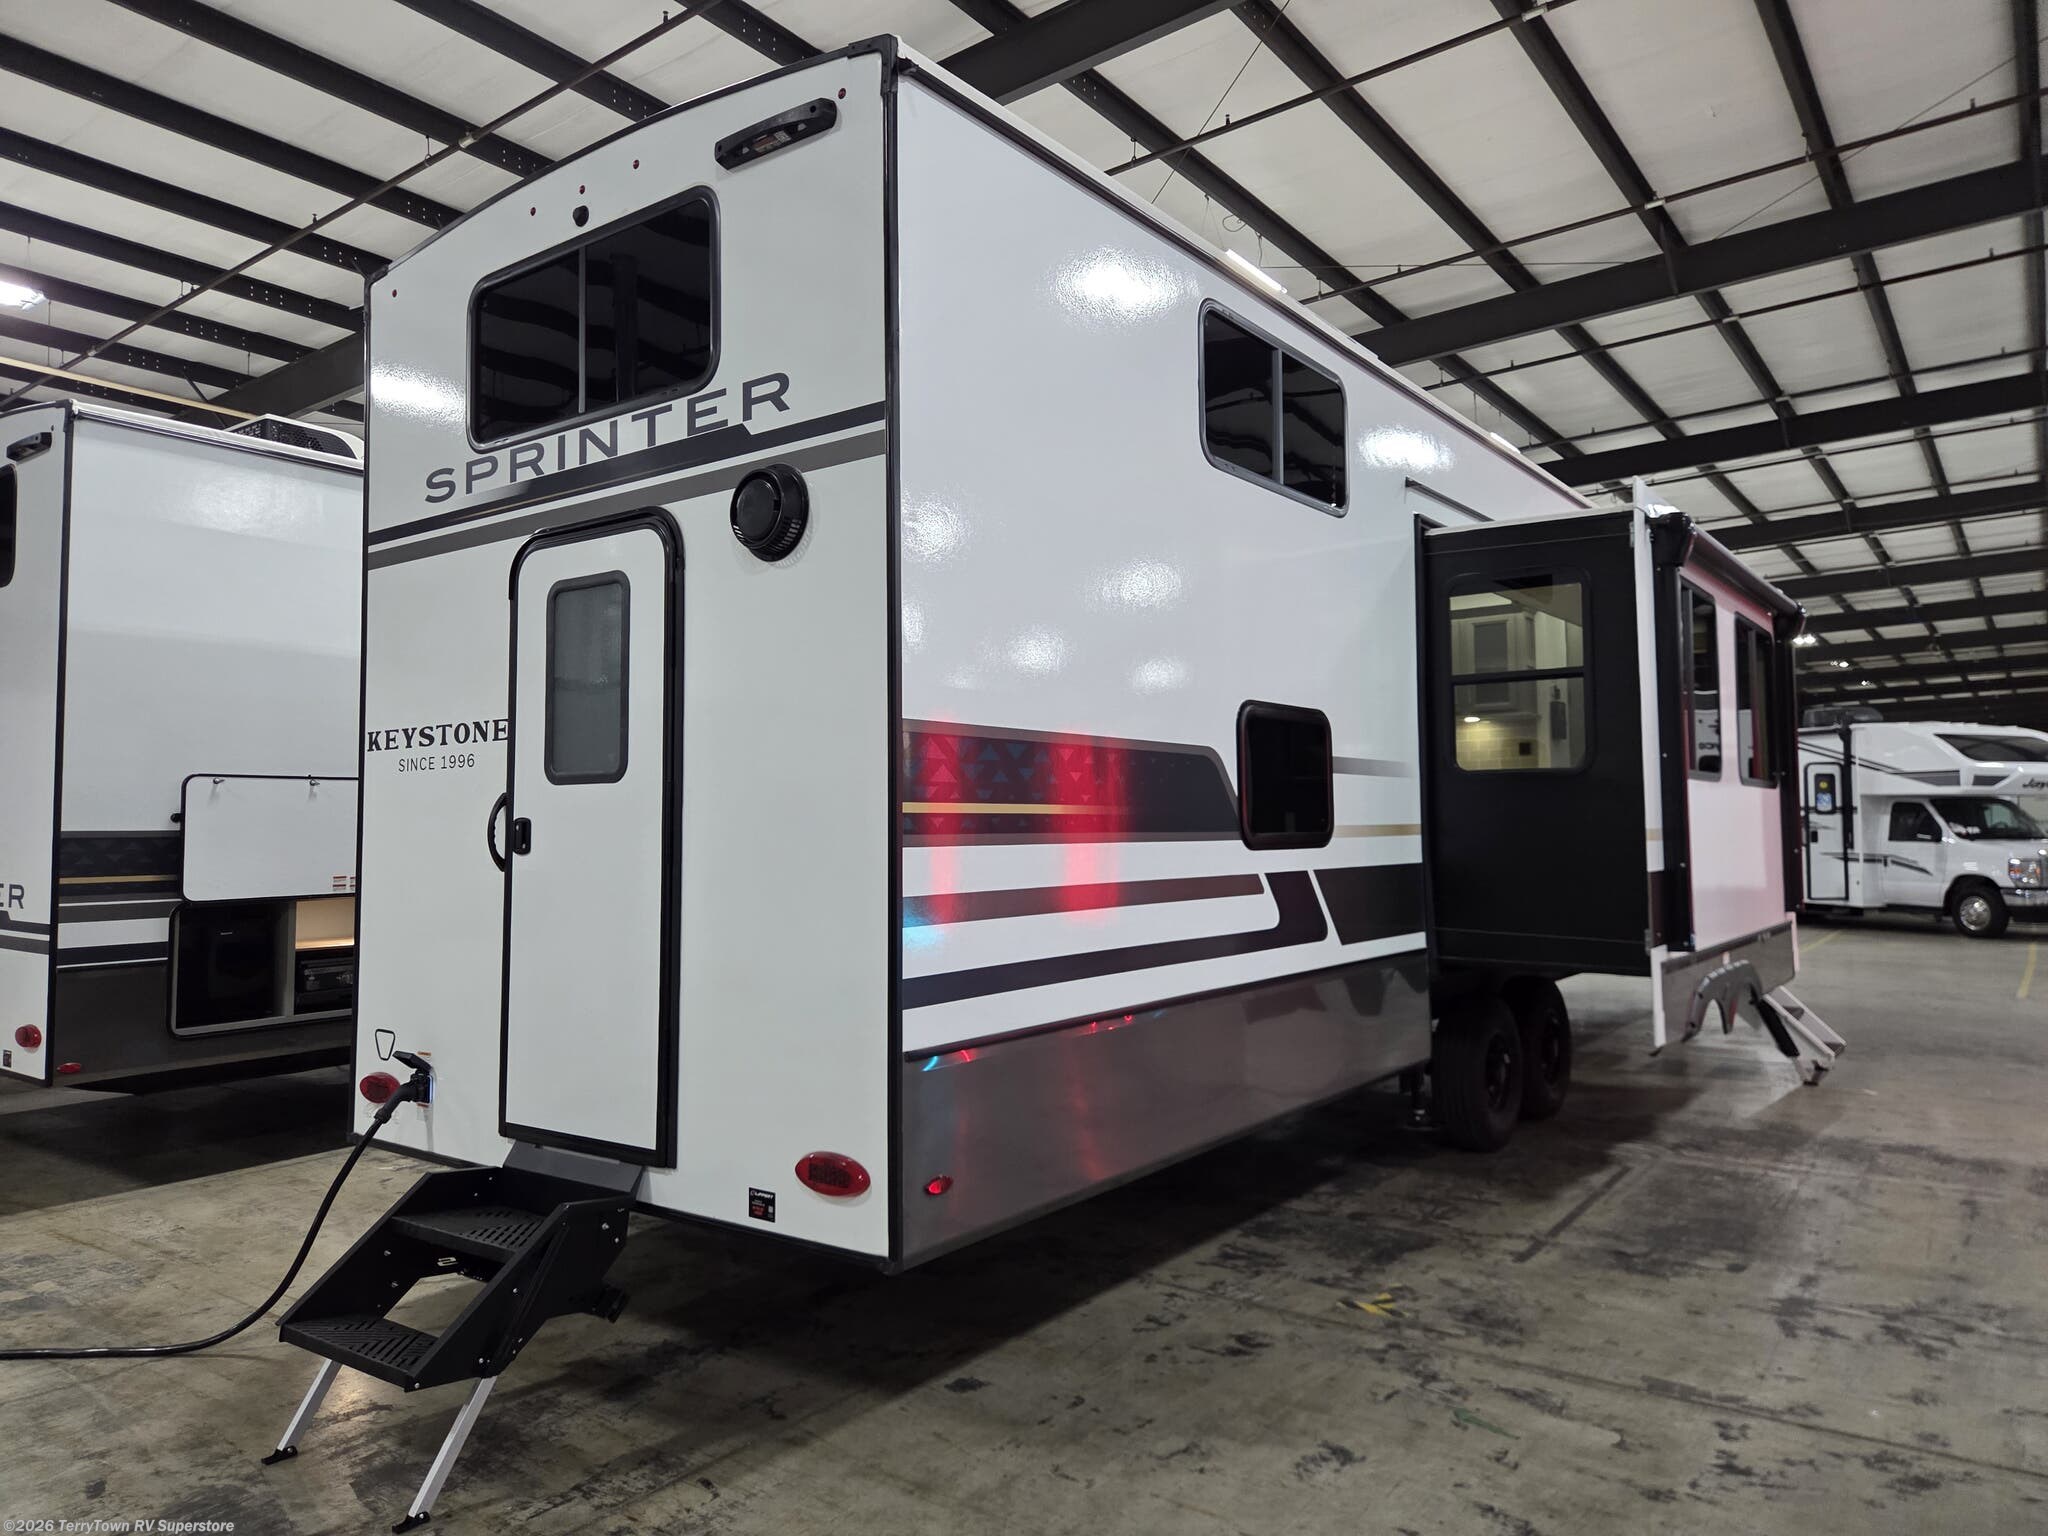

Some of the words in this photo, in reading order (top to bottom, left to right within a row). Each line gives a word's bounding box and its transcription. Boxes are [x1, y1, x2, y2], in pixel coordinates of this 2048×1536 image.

[425, 372, 790, 503] SPRINTER
[367, 718, 508, 751] KEYSTONE
[398, 756, 436, 772] SINCE
[441, 753, 475, 769] 1996
